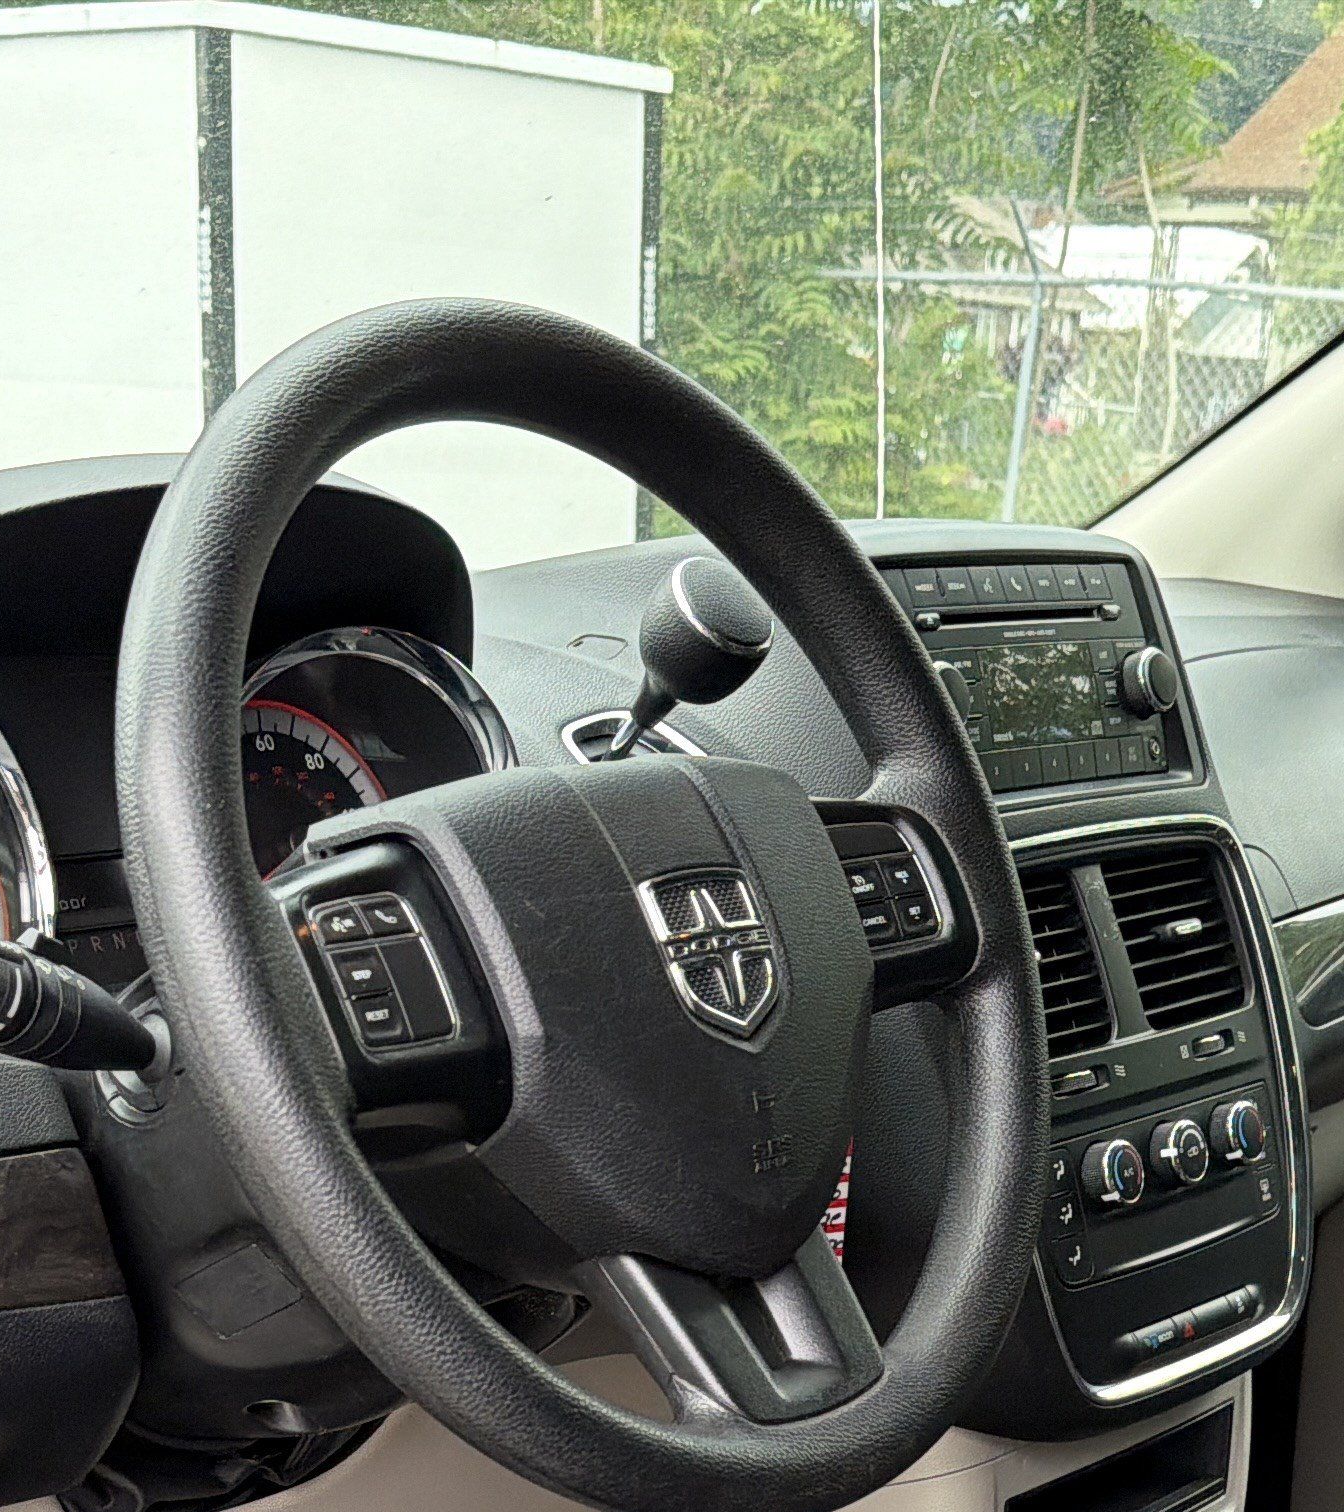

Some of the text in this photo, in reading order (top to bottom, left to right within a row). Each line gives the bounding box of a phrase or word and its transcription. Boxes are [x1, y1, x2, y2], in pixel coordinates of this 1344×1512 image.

[256, 734, 275, 752] 60
[305, 753, 324, 770] 80
[90, 936, 104, 952] R
[112, 932, 126, 950] N
[668, 929, 771, 958] DODGE
